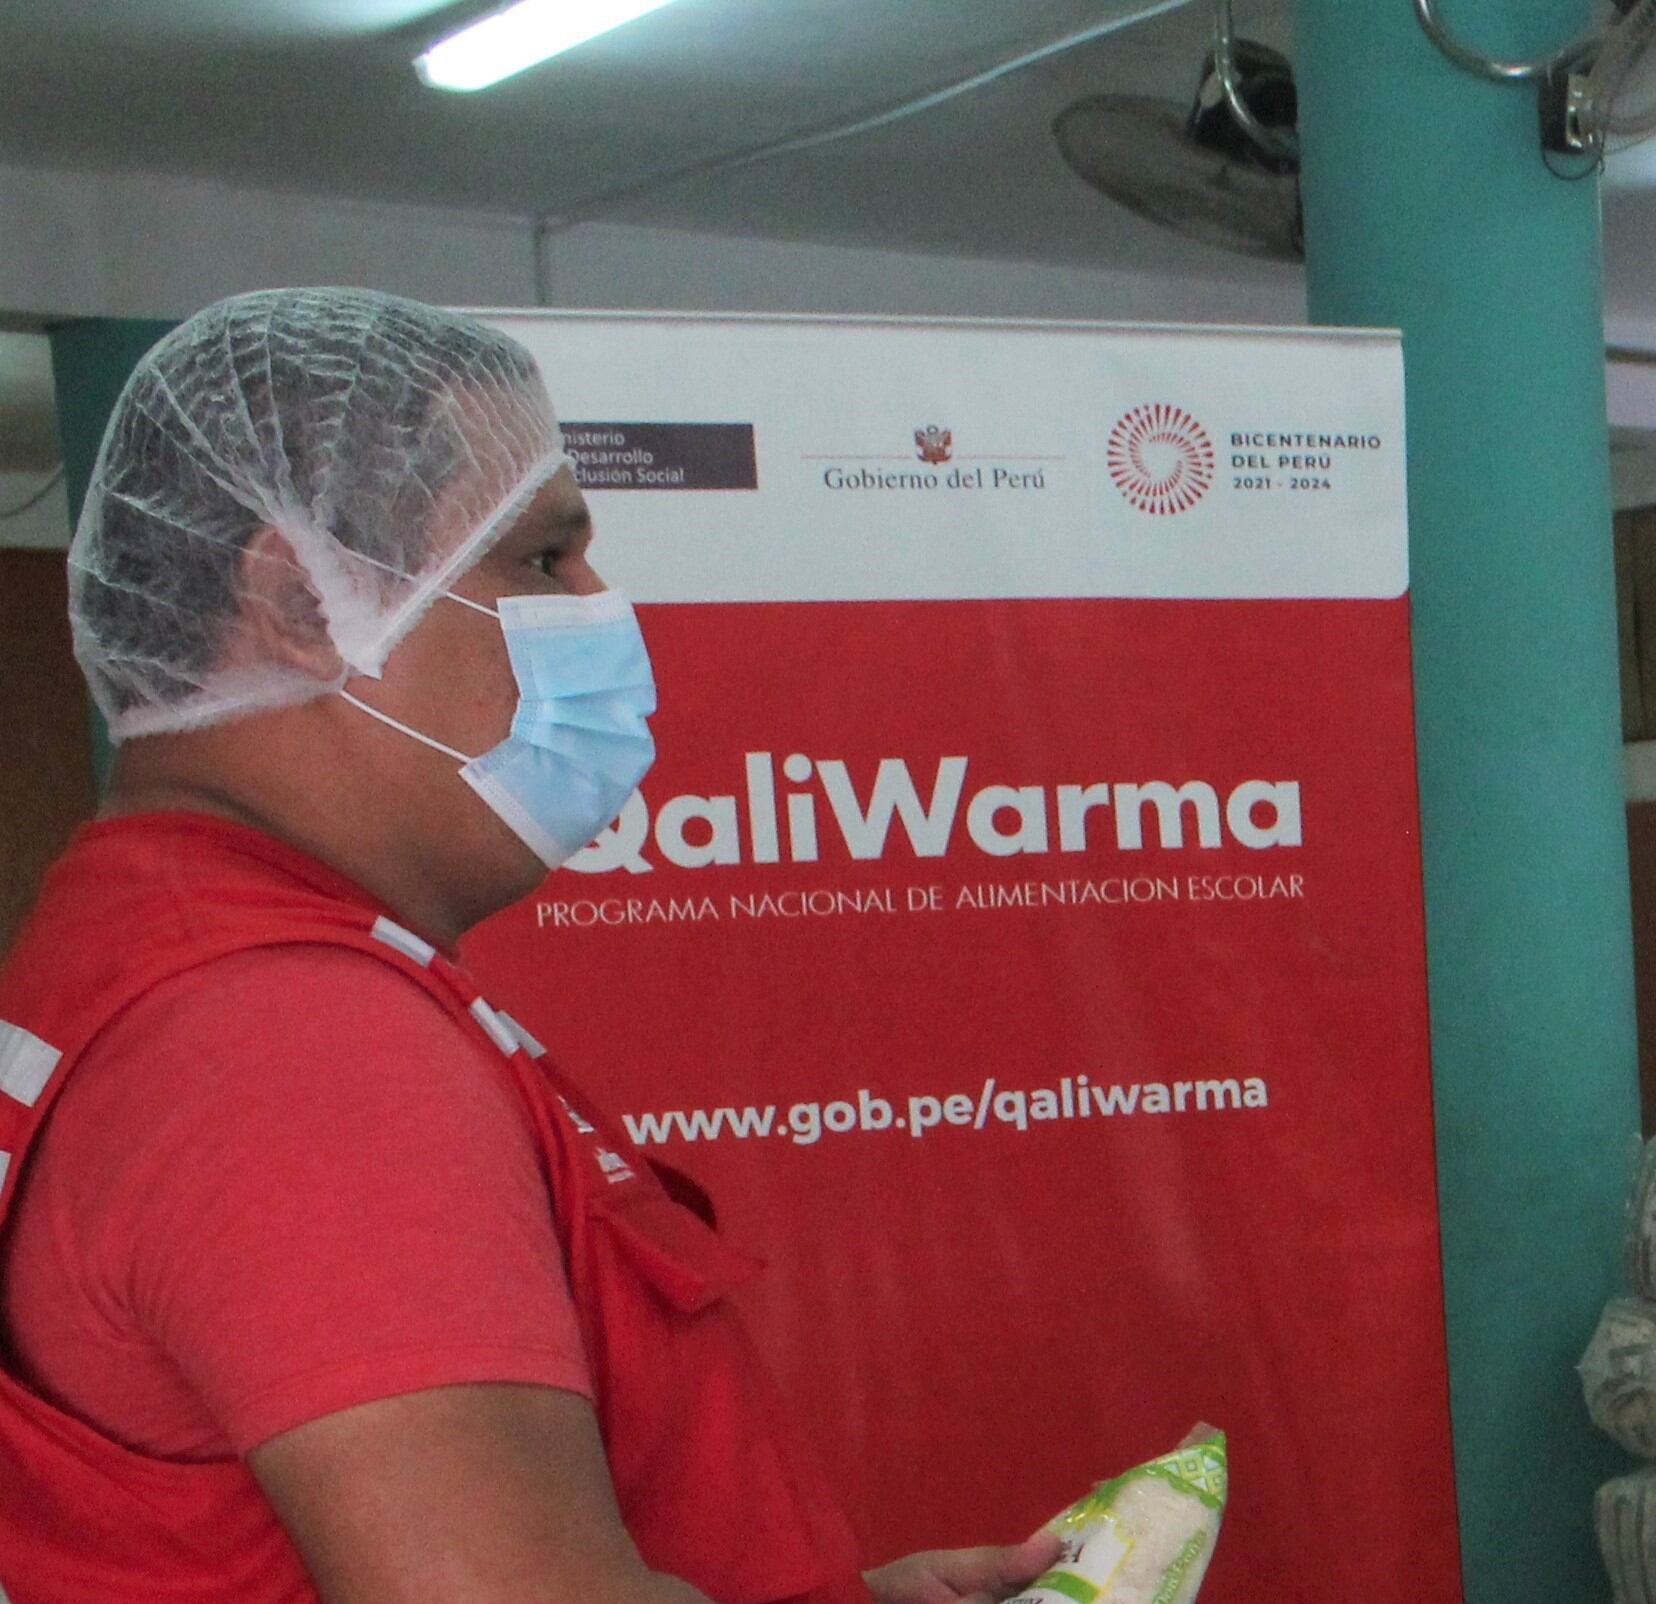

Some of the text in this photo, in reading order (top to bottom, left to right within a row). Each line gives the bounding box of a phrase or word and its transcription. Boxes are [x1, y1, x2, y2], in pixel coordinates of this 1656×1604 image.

[562, 430, 625, 446] nisterio
[1230, 433, 1382, 450] BICENTENARIO
[567, 449, 654, 464] Desarrollo
[1231, 455, 1270, 469] DEL
[575, 467, 685, 484] clusión Social
[823, 467, 1046, 490] Gobierno del Perú
[1232, 478, 1271, 490] 2021
[1290, 478, 1331, 490] 2024
[558, 751, 1303, 875] QaliWarma
[537, 897, 719, 929] PROGRAMA
[731, 888, 897, 919] NACIONAL
[908, 886, 943, 911] DE
[1188, 874, 1304, 903] ESCOLAR
[622, 1076, 1268, 1146] www.gob.pe/qaliwarma
